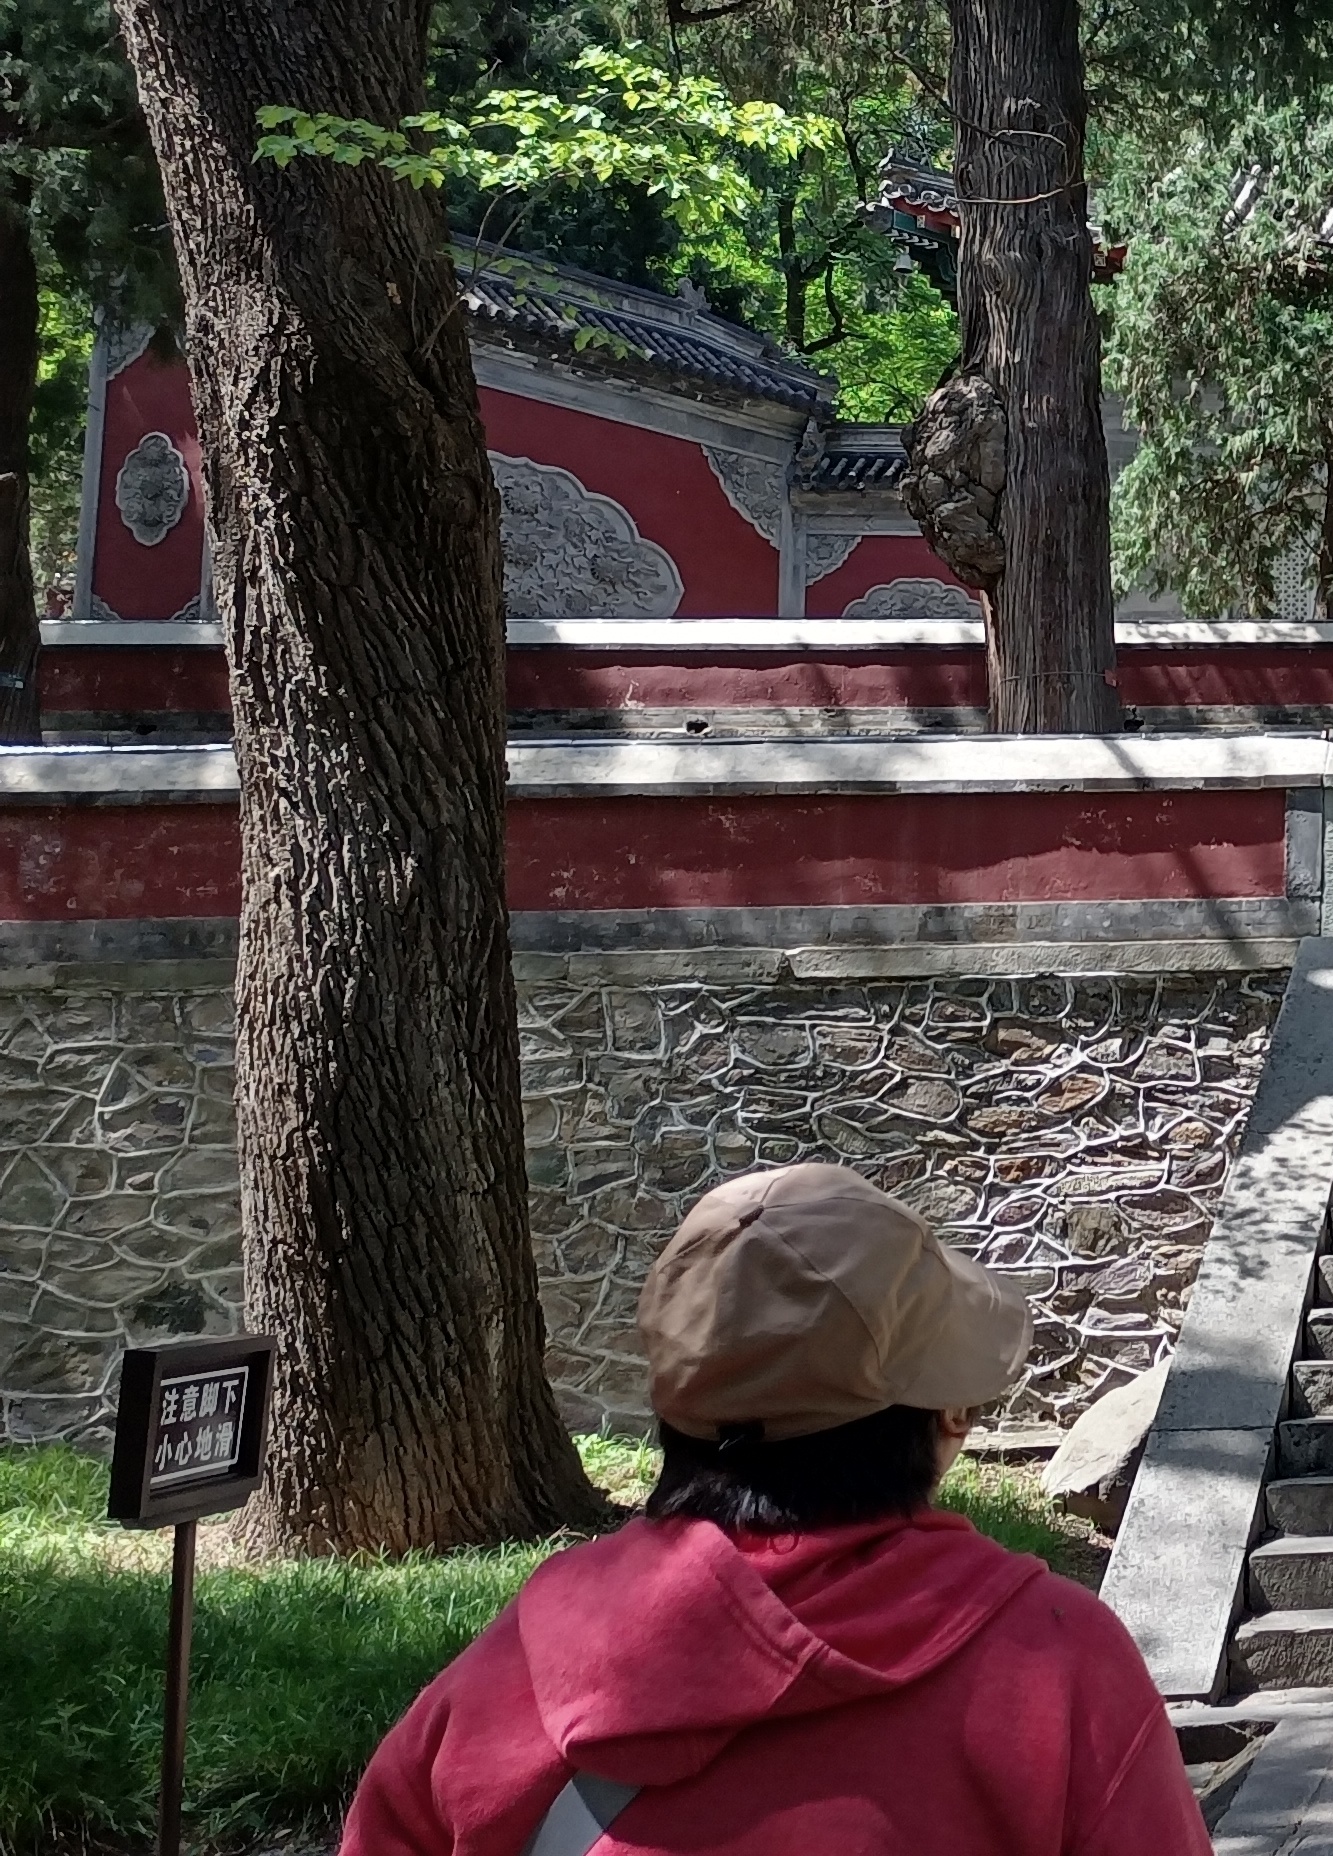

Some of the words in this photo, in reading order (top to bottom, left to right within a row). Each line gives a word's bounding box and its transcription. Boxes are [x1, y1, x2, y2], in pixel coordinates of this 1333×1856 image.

[160, 1379, 240, 1426] 注意脚下
[154, 1421, 234, 1471] 小心地滑
